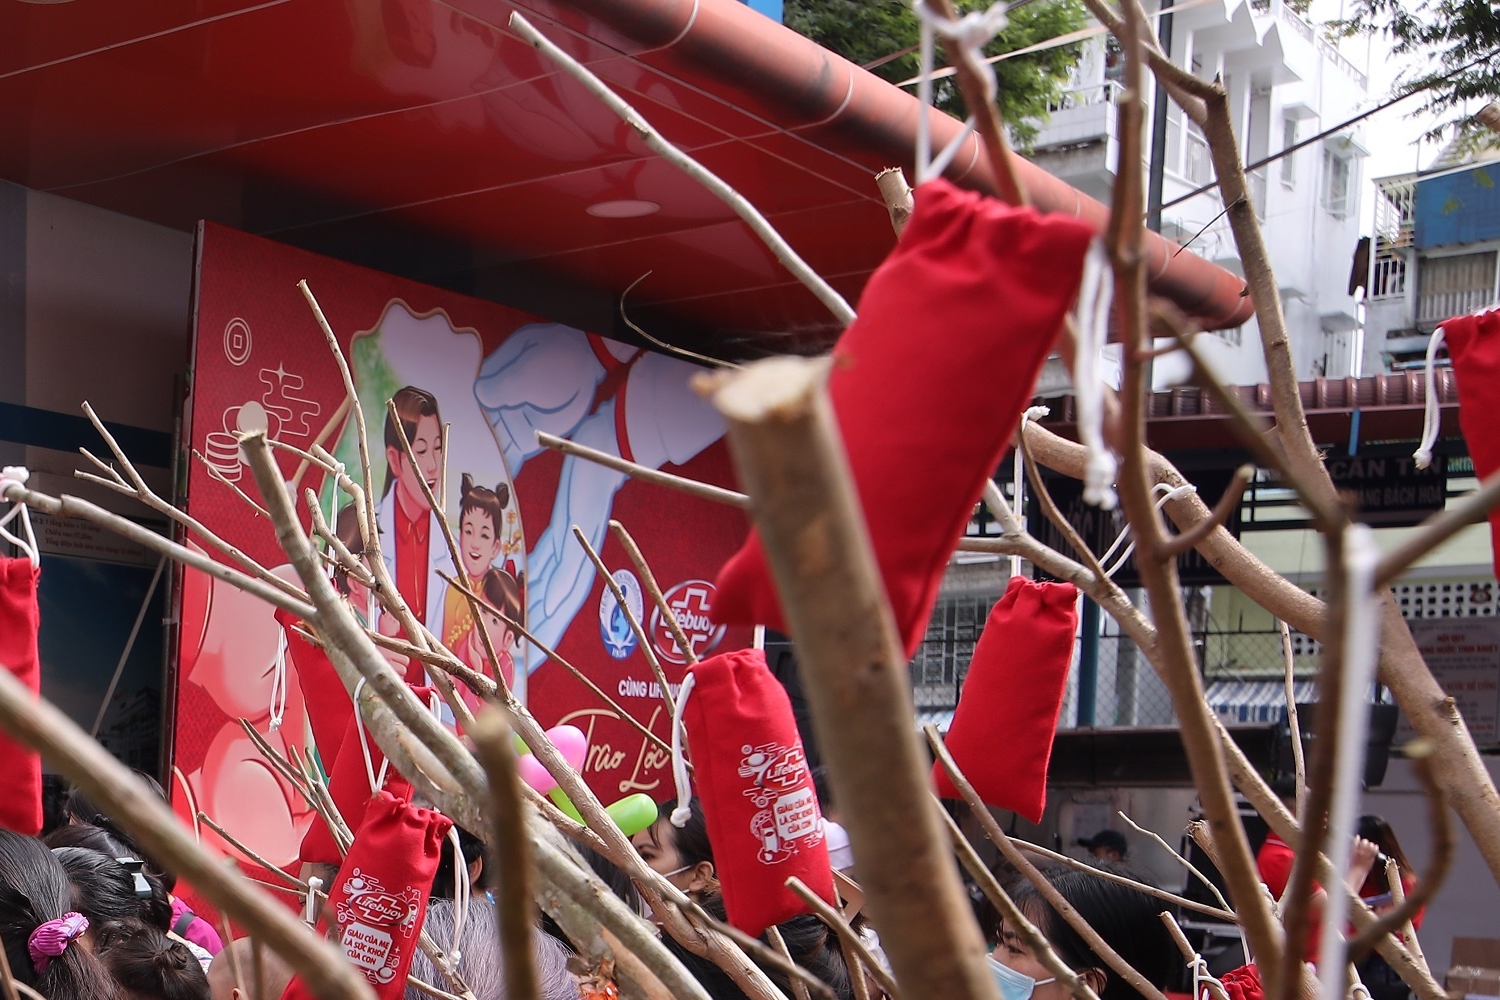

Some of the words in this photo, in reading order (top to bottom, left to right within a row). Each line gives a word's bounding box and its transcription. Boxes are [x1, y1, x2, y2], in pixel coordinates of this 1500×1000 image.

[659, 607, 717, 637] Lfebuoy
[618, 675, 648, 698] CÙNG
[355, 896, 404, 919] Lifebuoy
[344, 937, 353, 947] LÀ
[354, 940, 367, 952] SỨC
[347, 928, 364, 939] GIÀU
[365, 935, 378, 946] CỦA
[362, 955, 376, 965] CON
